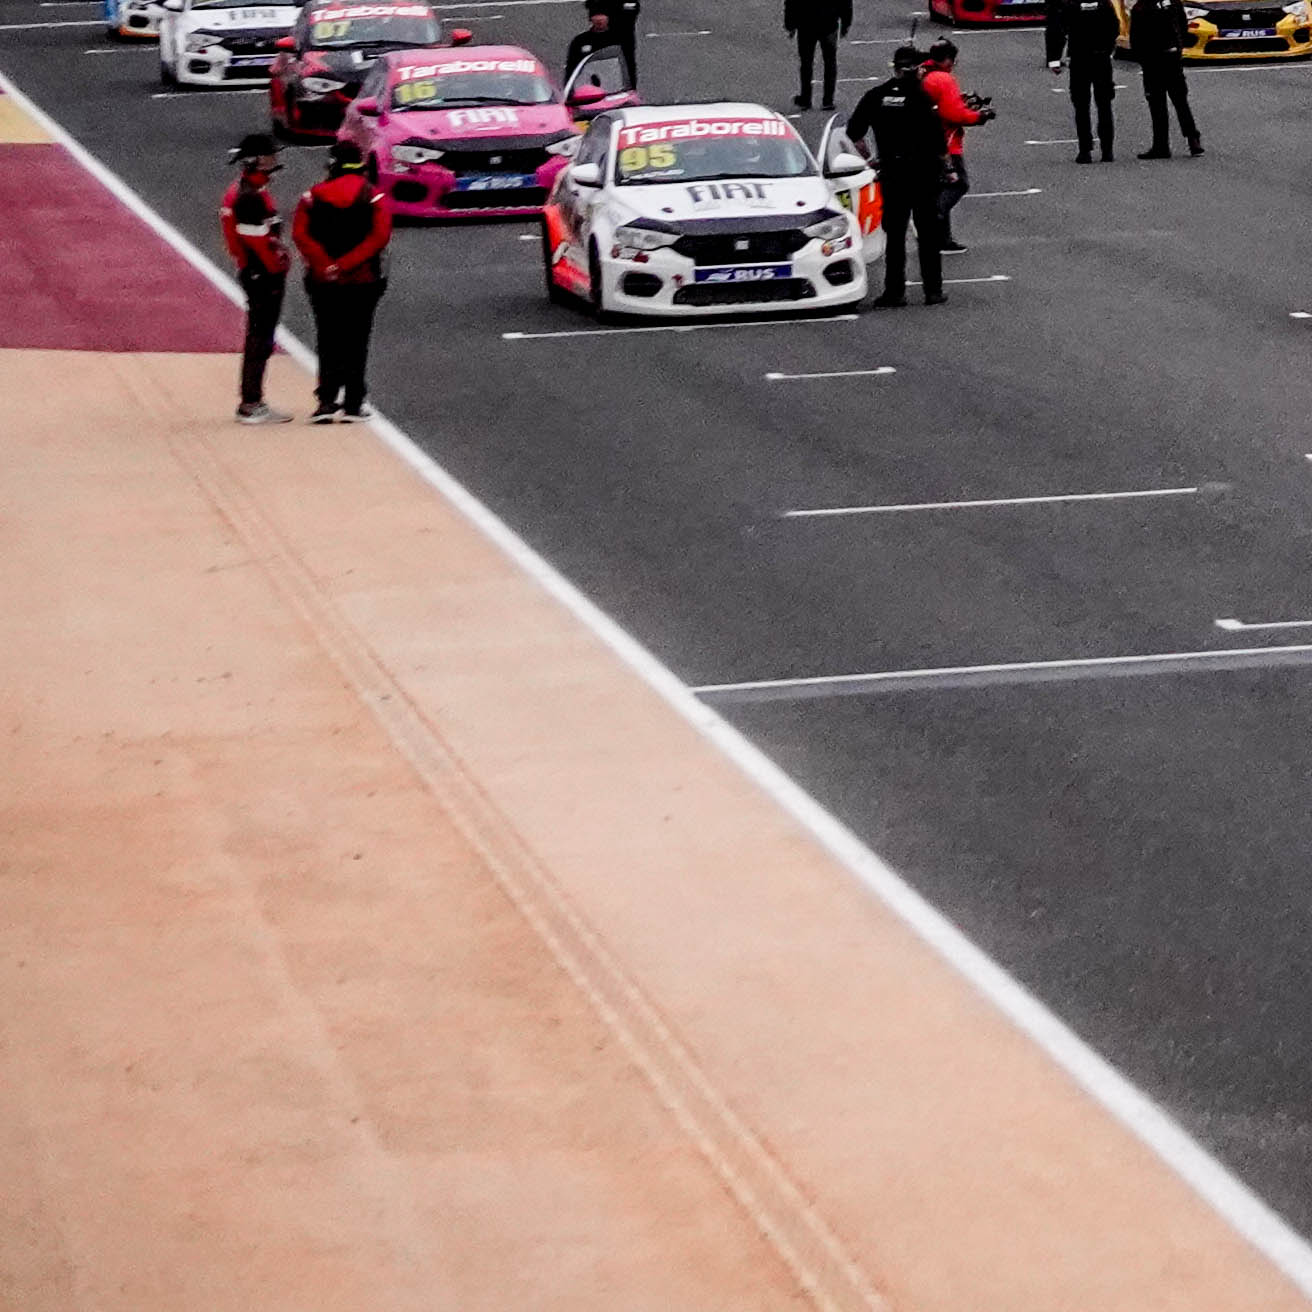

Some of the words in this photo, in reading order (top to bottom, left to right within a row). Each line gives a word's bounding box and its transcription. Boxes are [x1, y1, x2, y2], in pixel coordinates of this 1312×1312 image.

[397, 59, 537, 80] Taraborelli
[620, 118, 787, 146] Taraborelli
[618, 143, 678, 172] 95
[734, 268, 776, 281] RUS
